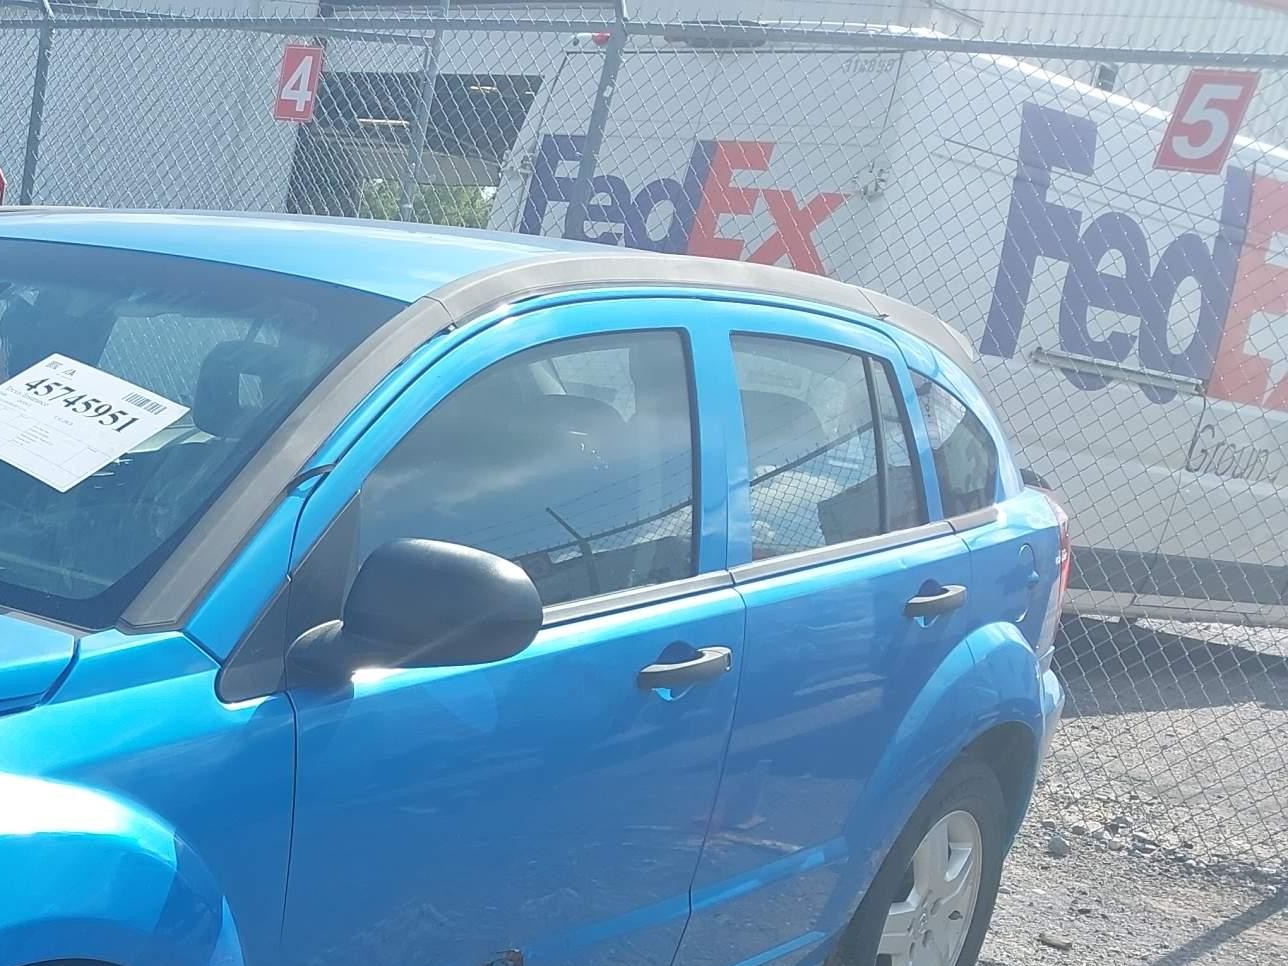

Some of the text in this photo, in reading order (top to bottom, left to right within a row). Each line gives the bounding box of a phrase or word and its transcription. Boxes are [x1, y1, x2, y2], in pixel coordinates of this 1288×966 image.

[280, 54, 314, 112] 4
[1171, 83, 1244, 160] 5
[518, 134, 852, 277] FedEx
[978, 101, 1288, 412] FedE
[25, 377, 141, 433] 45745951
[1185, 424, 1280, 485] Groun
